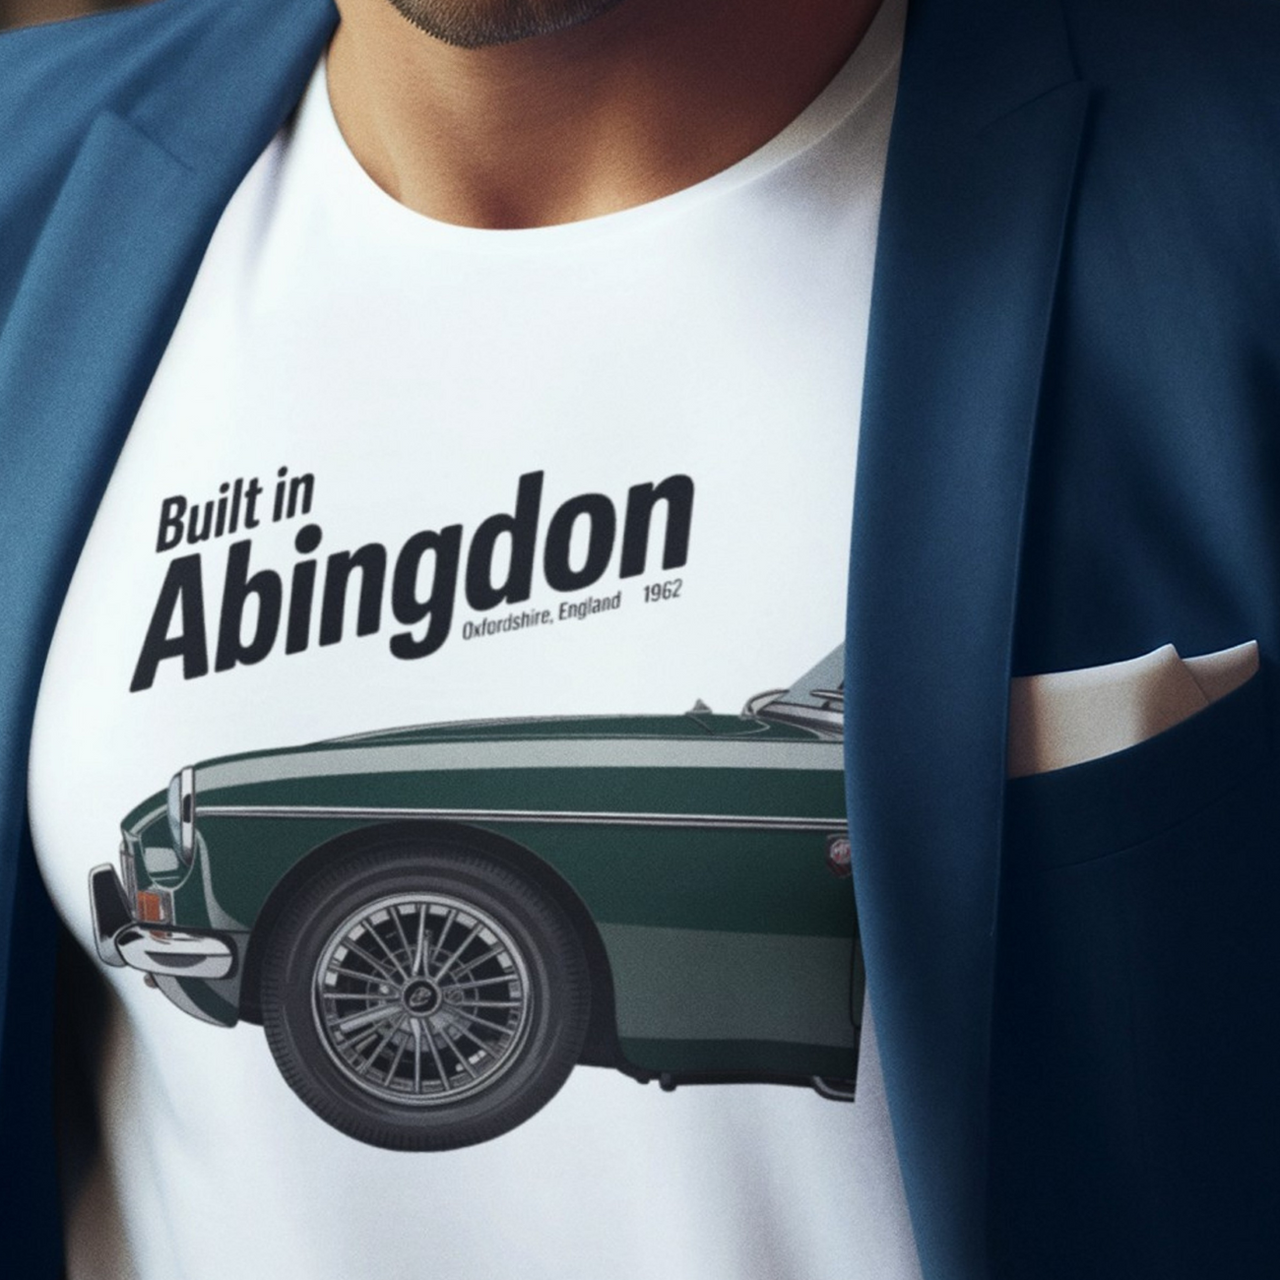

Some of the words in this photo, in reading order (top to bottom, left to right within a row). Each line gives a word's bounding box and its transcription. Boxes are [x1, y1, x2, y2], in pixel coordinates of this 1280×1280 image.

[155, 477, 263, 554] Built
[272, 466, 315, 523] in
[129, 470, 695, 693] Abingdon
[462, 608, 554, 640] Oxfordshire,
[558, 590, 622, 621] England
[643, 578, 683, 603] 1962
